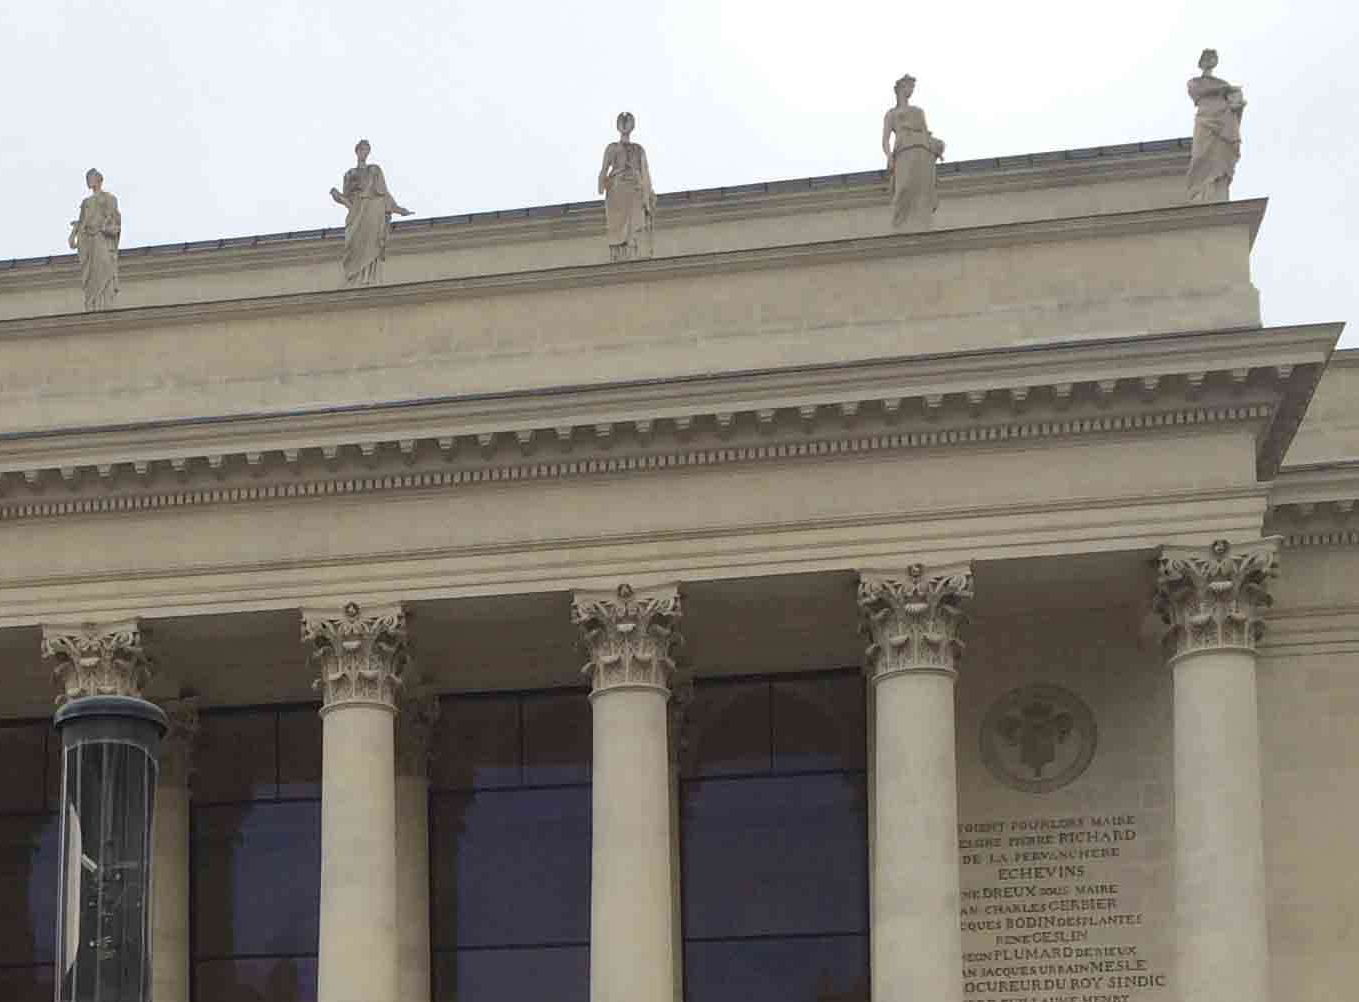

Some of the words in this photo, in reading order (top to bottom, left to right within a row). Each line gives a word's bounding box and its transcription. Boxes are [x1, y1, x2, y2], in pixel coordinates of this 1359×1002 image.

[1058, 830, 1136, 844] RICHARD
[963, 853, 980, 865] DE
[998, 865, 1086, 881] ECHEVINS
[982, 885, 1036, 899] DREUX
[961, 904, 978, 917] AN
[962, 967, 977, 978] AN
[964, 979, 1042, 993] OCUREUR
[1043, 978, 1066, 991] DU
[1070, 976, 1104, 991] ROY
[1106, 974, 1167, 989] SINDIC
